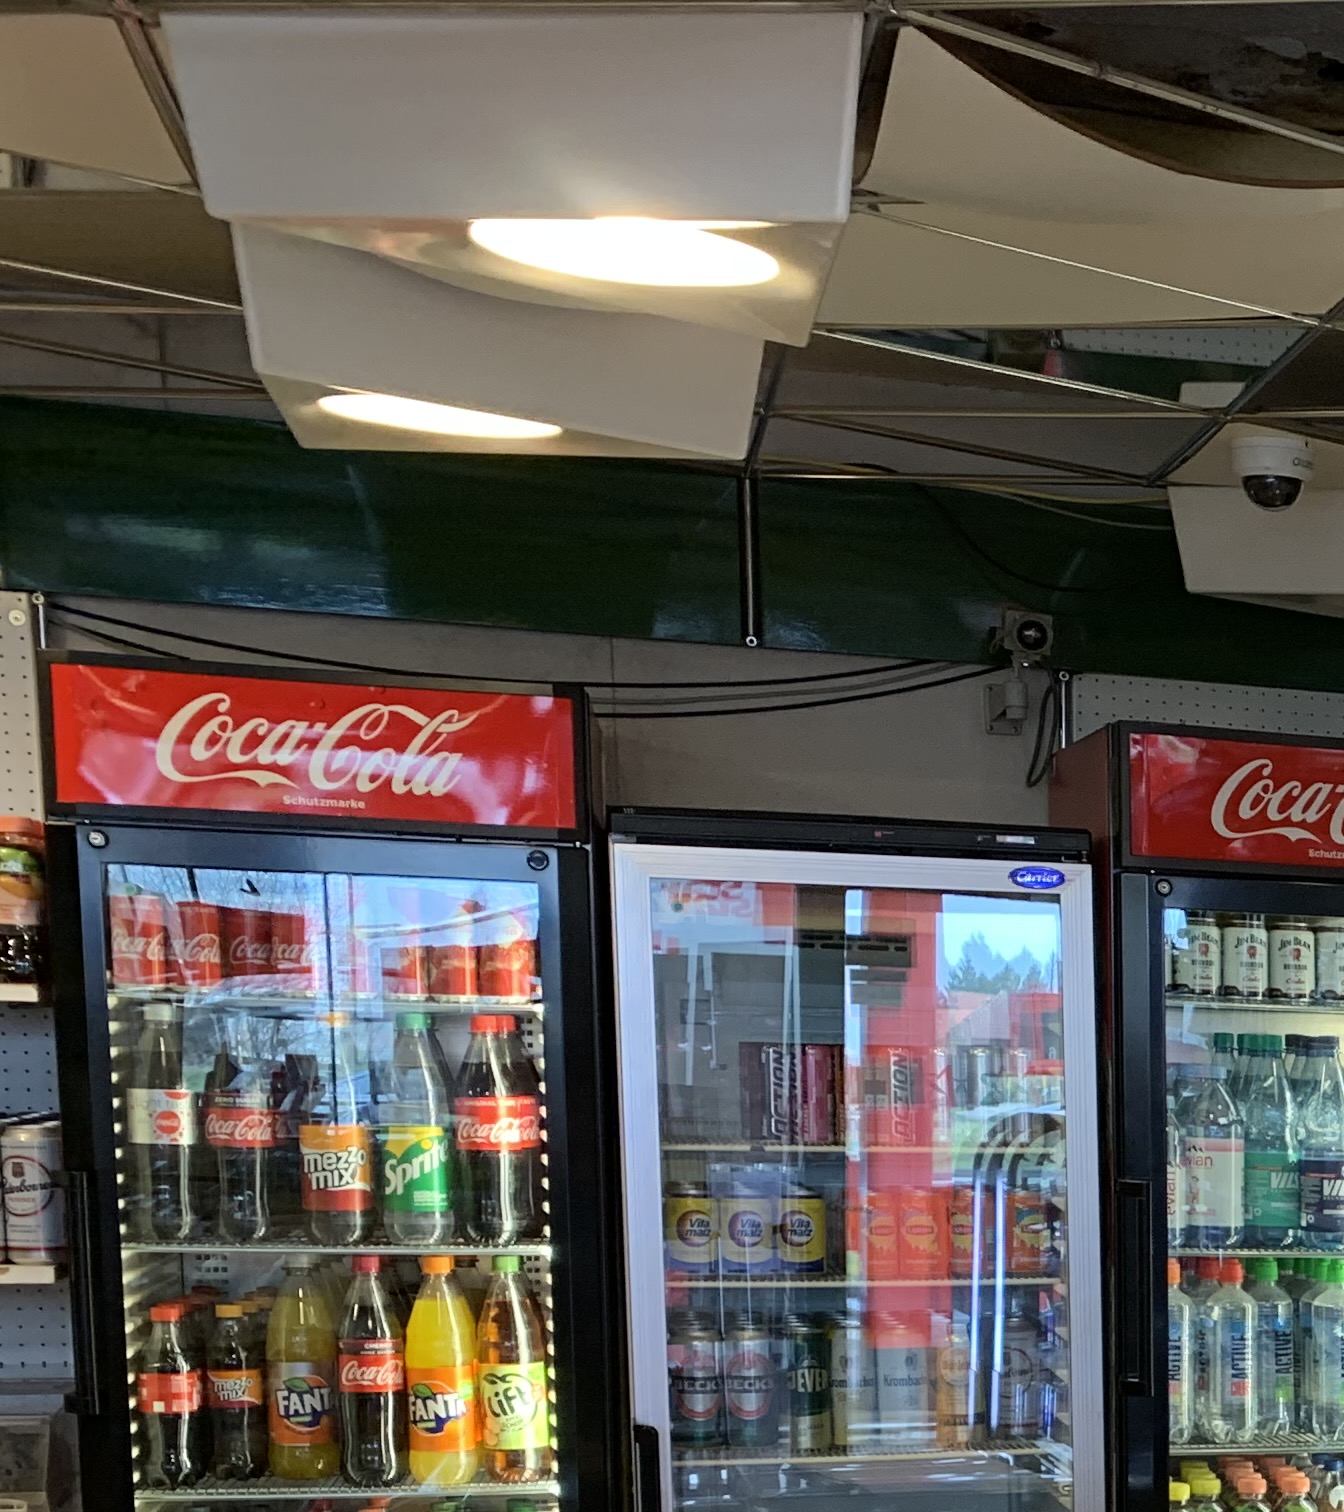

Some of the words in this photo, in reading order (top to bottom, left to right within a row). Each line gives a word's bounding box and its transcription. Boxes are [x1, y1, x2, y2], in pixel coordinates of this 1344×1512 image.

[157, 692, 478, 797] Coca-Cola
[282, 793, 365, 811] Schutzmarke
[1015, 869, 1060, 884] Carrier
[303, 1147, 367, 1169] mezzo
[383, 1139, 449, 1195] Sprite
[308, 1165, 358, 1189] mix
[1231, 1334, 1248, 1380] ACTIVE
[1275, 1330, 1292, 1375] ACTIVE
[787, 1367, 828, 1393] JEVER
